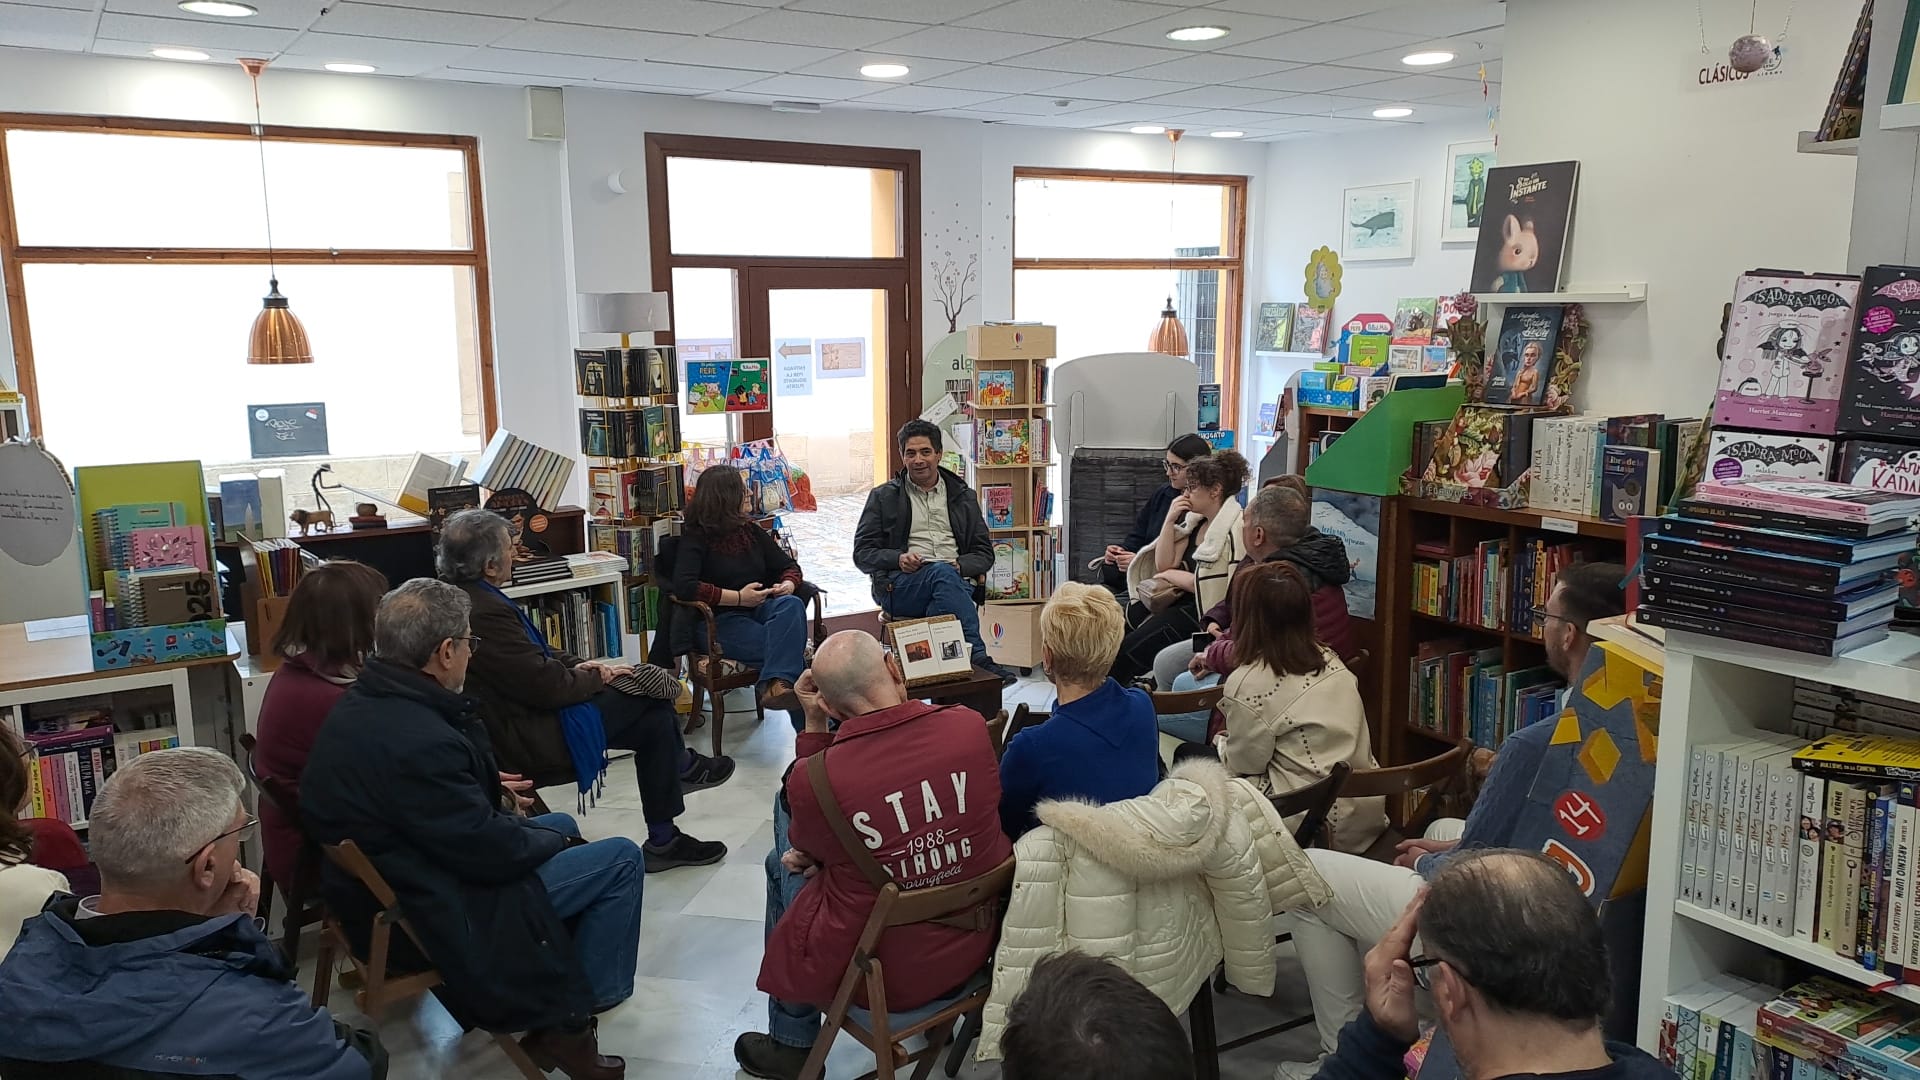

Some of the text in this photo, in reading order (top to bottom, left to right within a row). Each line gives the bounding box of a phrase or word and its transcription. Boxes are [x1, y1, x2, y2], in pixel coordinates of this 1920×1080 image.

[1509, 180, 1548, 201] INSTANTE
[1886, 281, 1920, 297] ISAD
[1533, 449, 1542, 481] ALICIA
[1727, 443, 1777, 463] ISADORA
[1872, 466, 1920, 493] KADA
[852, 771, 967, 849] STAY
[1559, 792, 1602, 836] 14
[1833, 790, 1843, 816] VERNE
[906, 828, 945, 856] 1988
[1896, 844, 1907, 877] ARSENIO
[1894, 877, 1906, 899] LUPIN
[1892, 901, 1902, 931] CABALLERO
